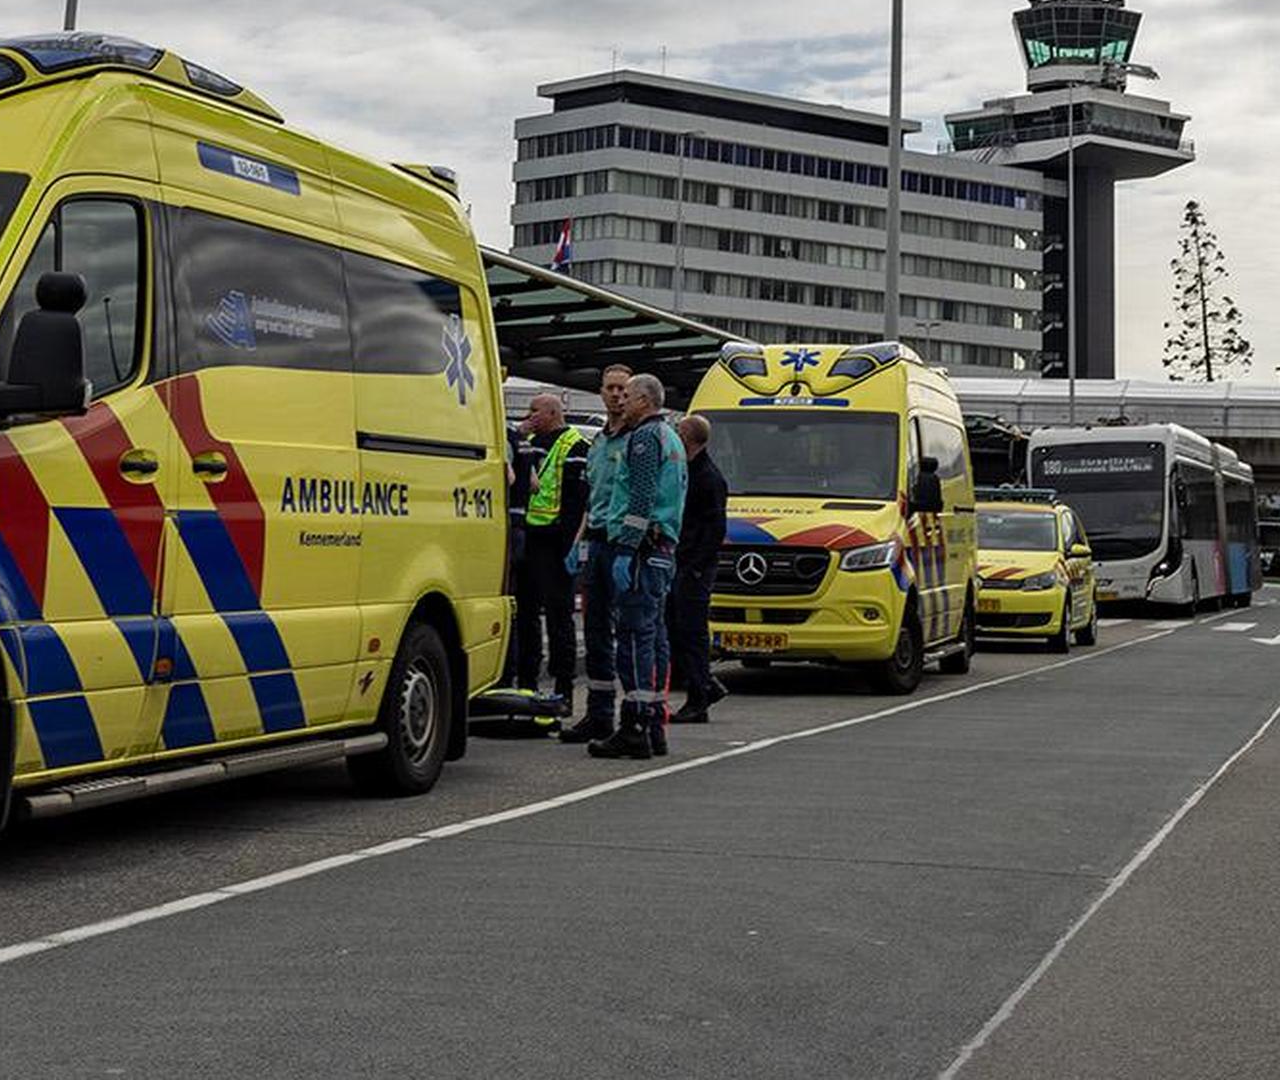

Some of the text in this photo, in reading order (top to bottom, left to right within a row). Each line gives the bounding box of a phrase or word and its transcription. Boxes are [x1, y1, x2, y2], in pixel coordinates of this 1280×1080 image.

[280, 476, 493, 519] AMBULANCE 12-161
[299, 530, 362, 547] Kennemerland
